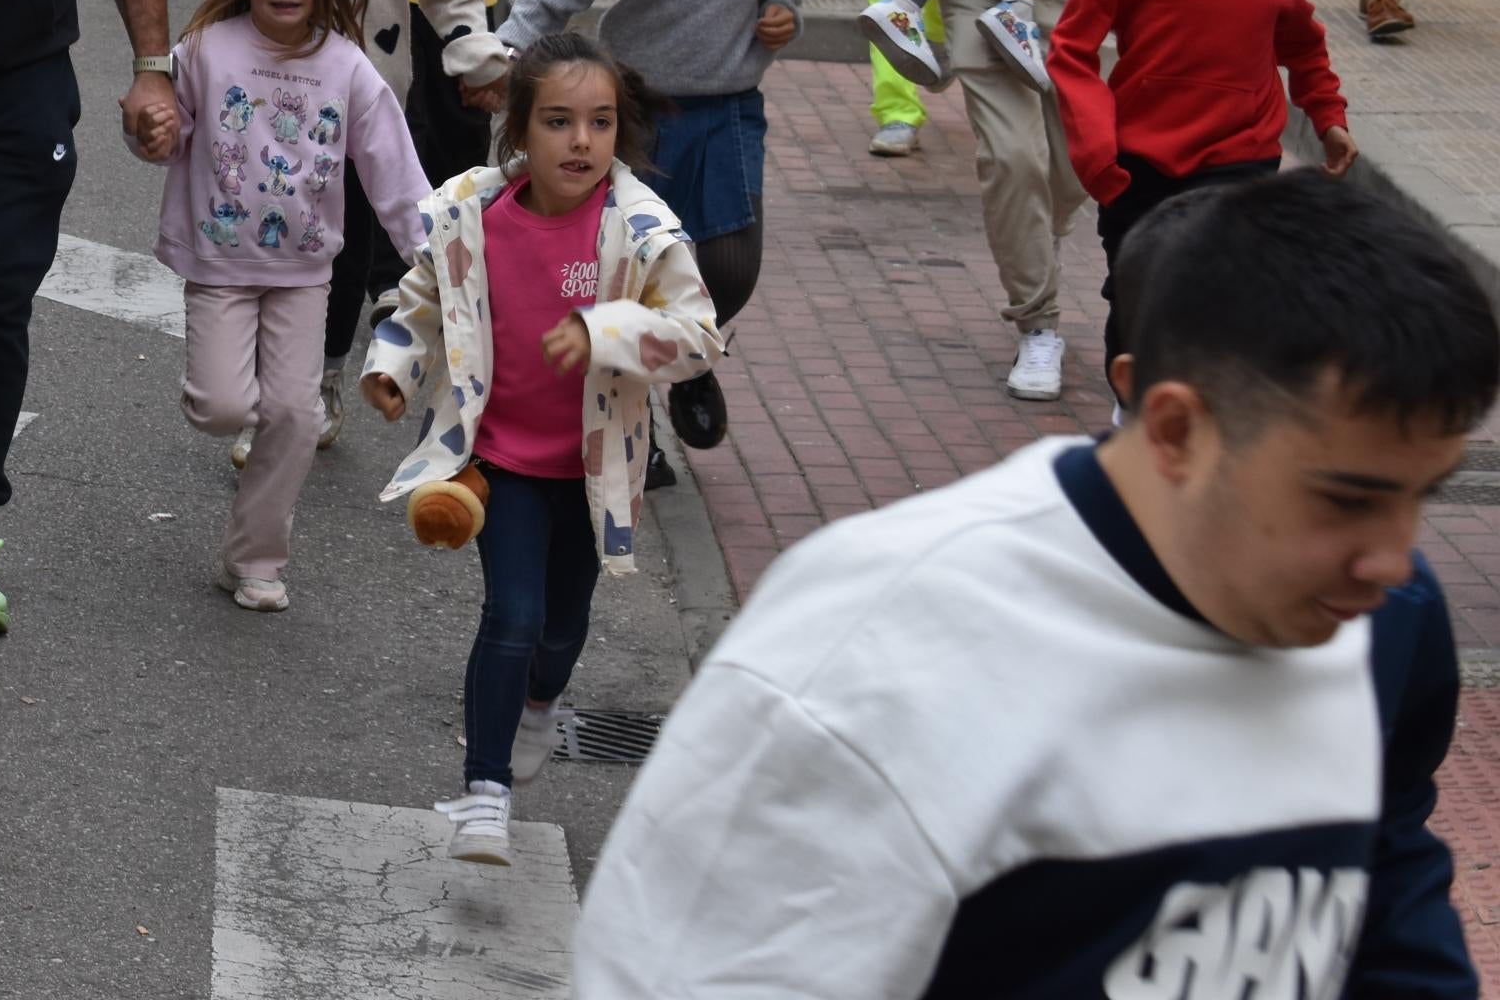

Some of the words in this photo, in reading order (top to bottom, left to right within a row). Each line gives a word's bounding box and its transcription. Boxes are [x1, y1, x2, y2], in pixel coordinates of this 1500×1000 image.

[251, 68, 281, 80] ANGEL
[292, 75, 322, 87] STITCH
[560, 278, 597, 298] SPOR
